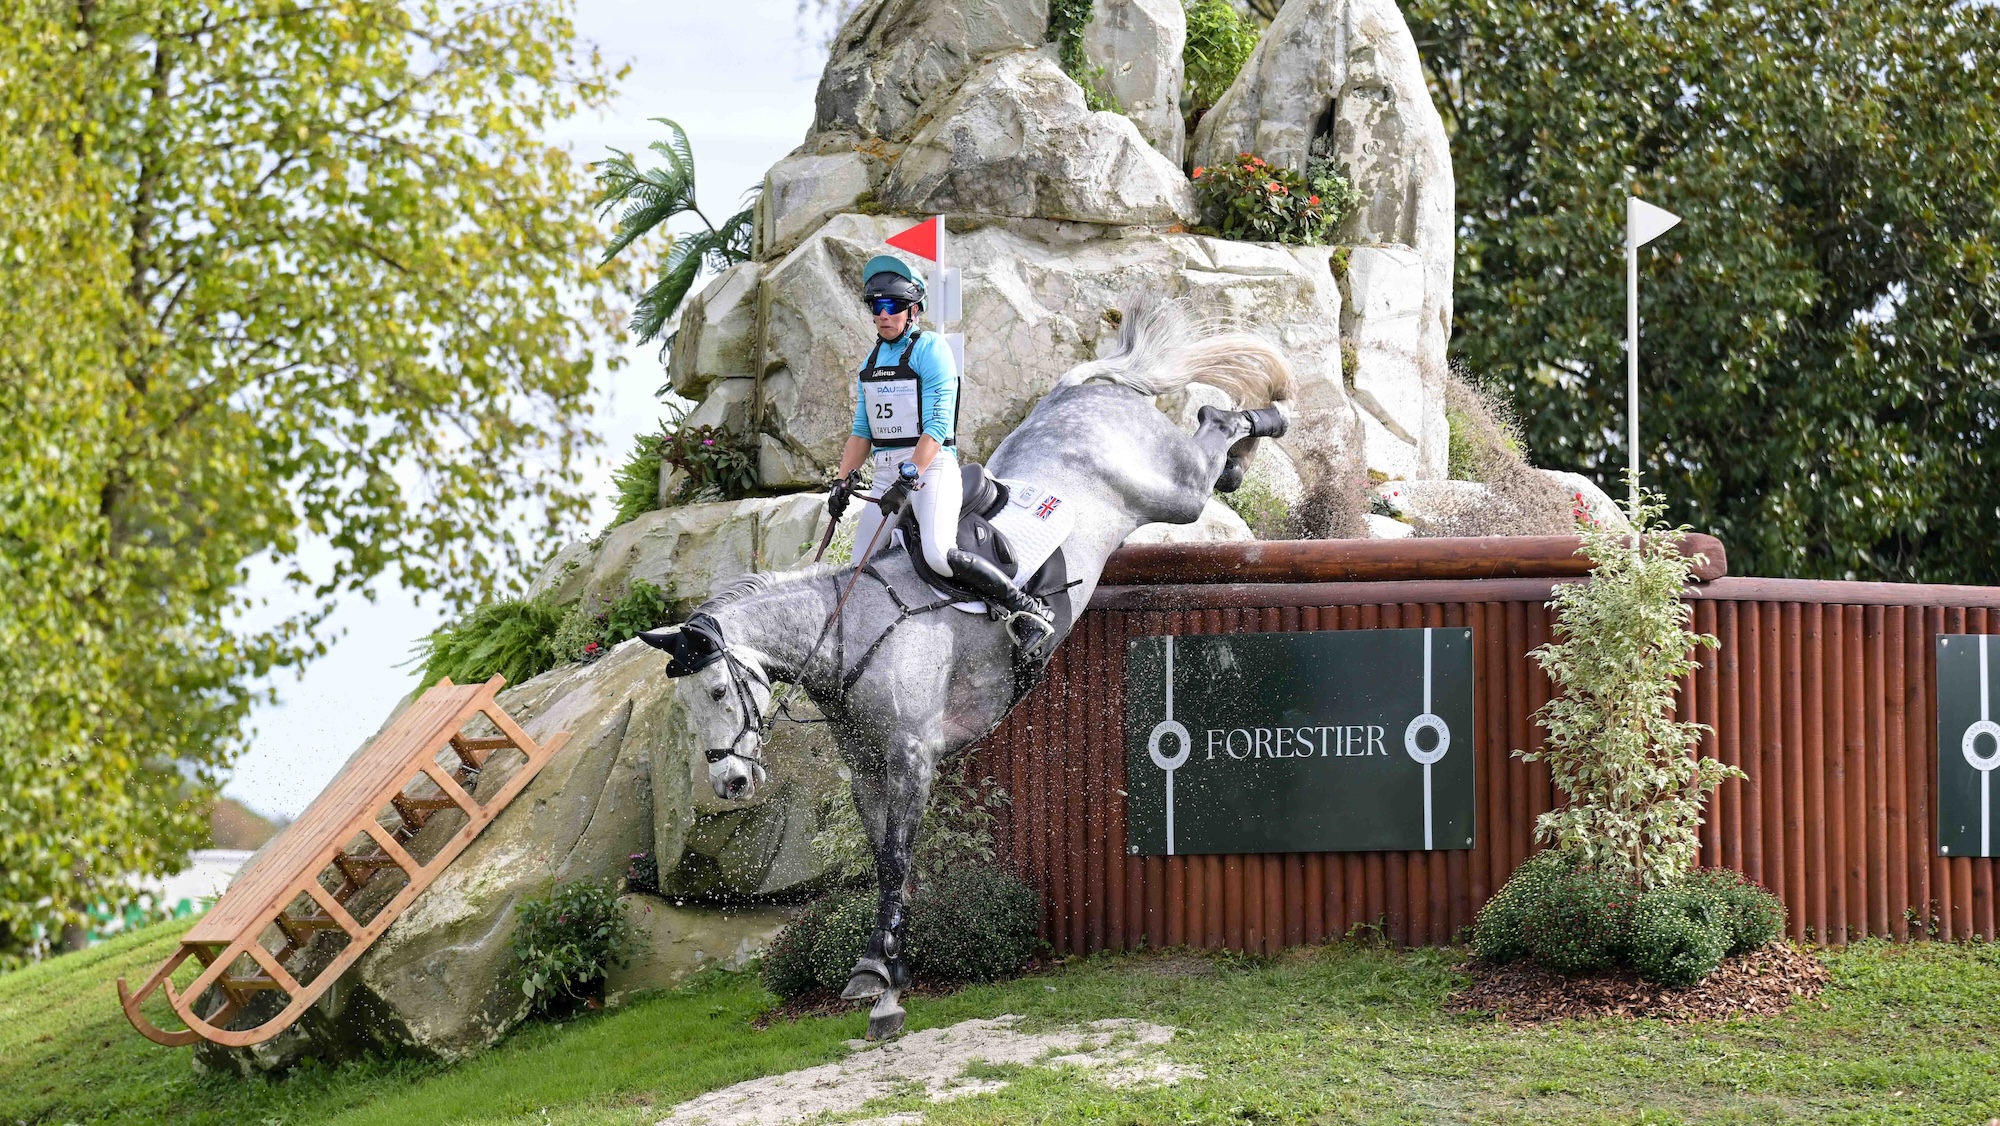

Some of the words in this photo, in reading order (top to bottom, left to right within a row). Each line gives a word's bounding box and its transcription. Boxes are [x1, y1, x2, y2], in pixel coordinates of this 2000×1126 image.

[877, 385, 896, 394] PAU
[875, 403, 893, 419] 25
[877, 426, 903, 434] TAYLOR
[1152, 722, 1187, 741] FORESTIER
[1409, 716, 1445, 734] FORESTIER
[1206, 725, 1388, 760] FORESTIER
